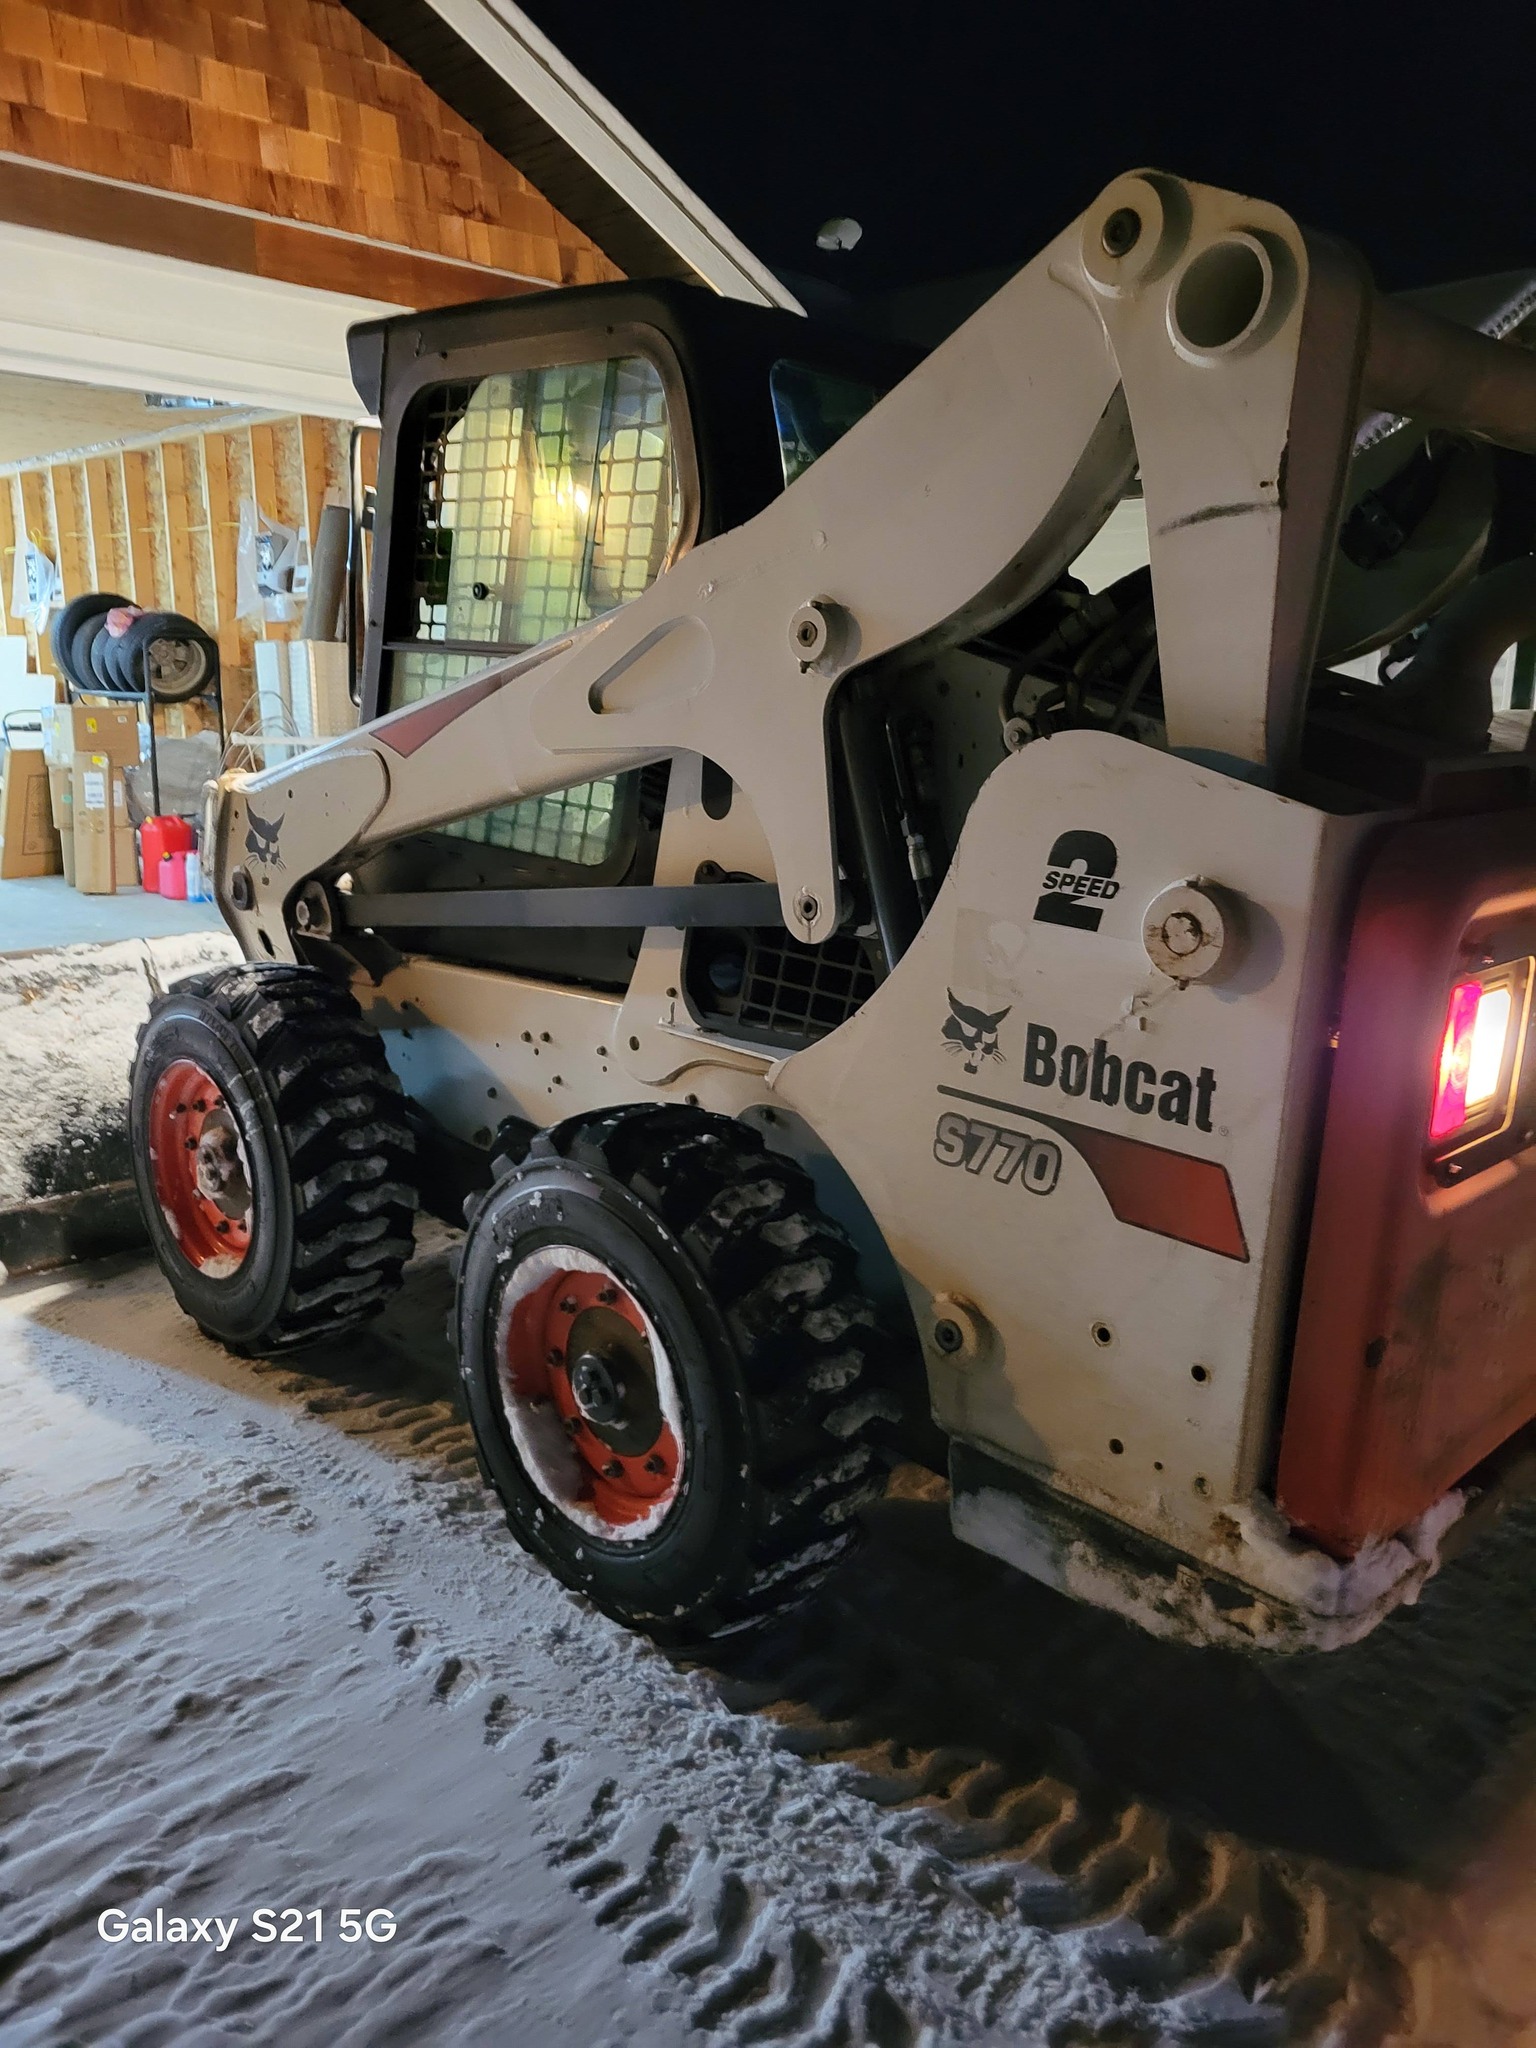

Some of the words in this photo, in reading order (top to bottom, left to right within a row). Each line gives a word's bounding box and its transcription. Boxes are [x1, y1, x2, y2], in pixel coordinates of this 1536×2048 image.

[1033, 829, 1118, 932] 2
[1042, 871, 1120, 900] SPEED
[1023, 1022, 1217, 1133] Bobcat
[933, 1111, 1062, 1196] S770
